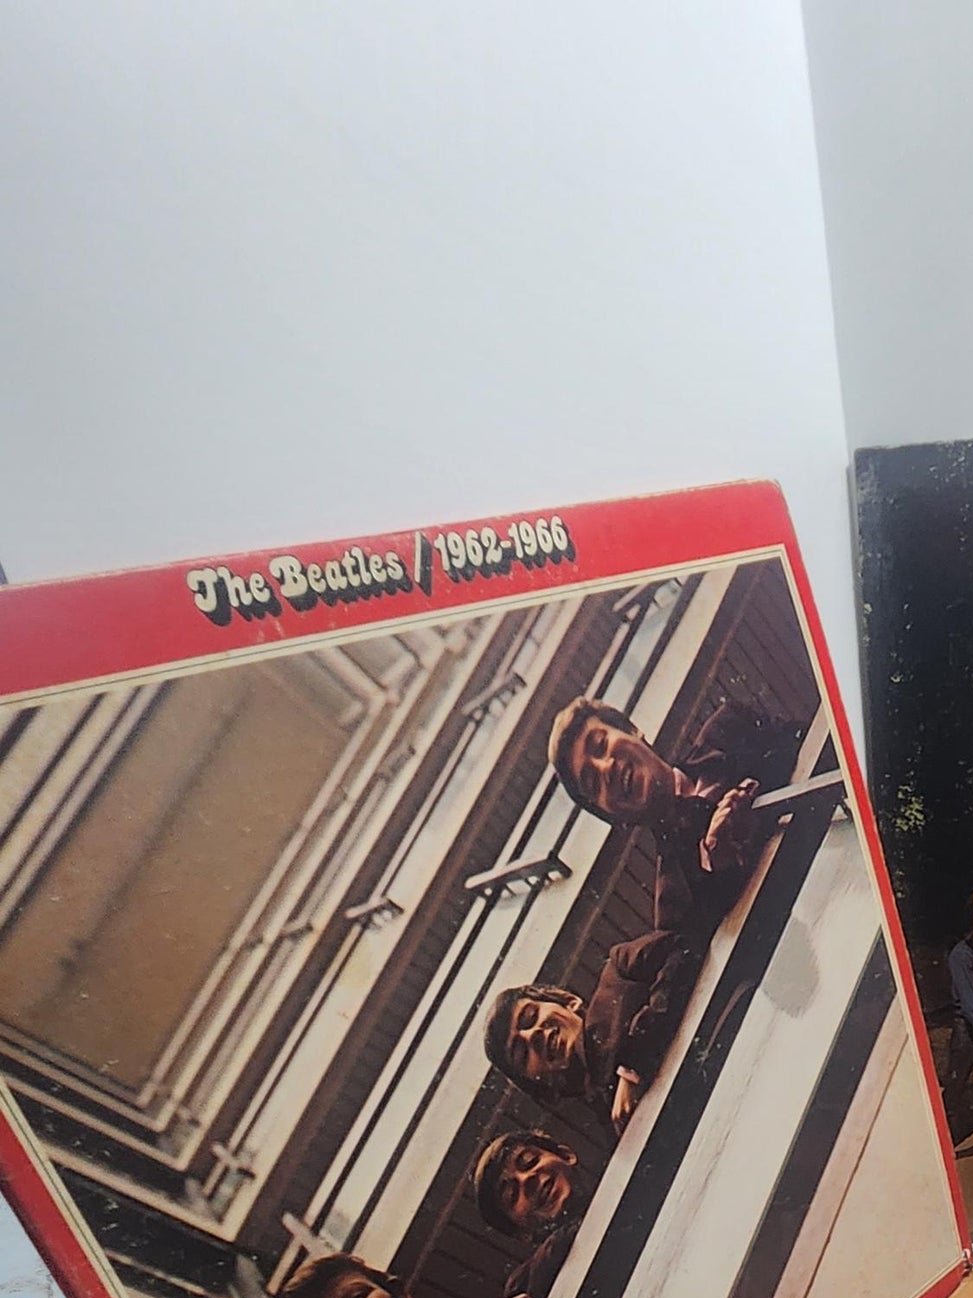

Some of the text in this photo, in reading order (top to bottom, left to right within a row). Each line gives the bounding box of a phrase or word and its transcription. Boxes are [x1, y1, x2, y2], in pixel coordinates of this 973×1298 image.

[186, 564, 276, 621] The
[269, 545, 407, 606] Beatles
[434, 514, 573, 579] 1962-1966
